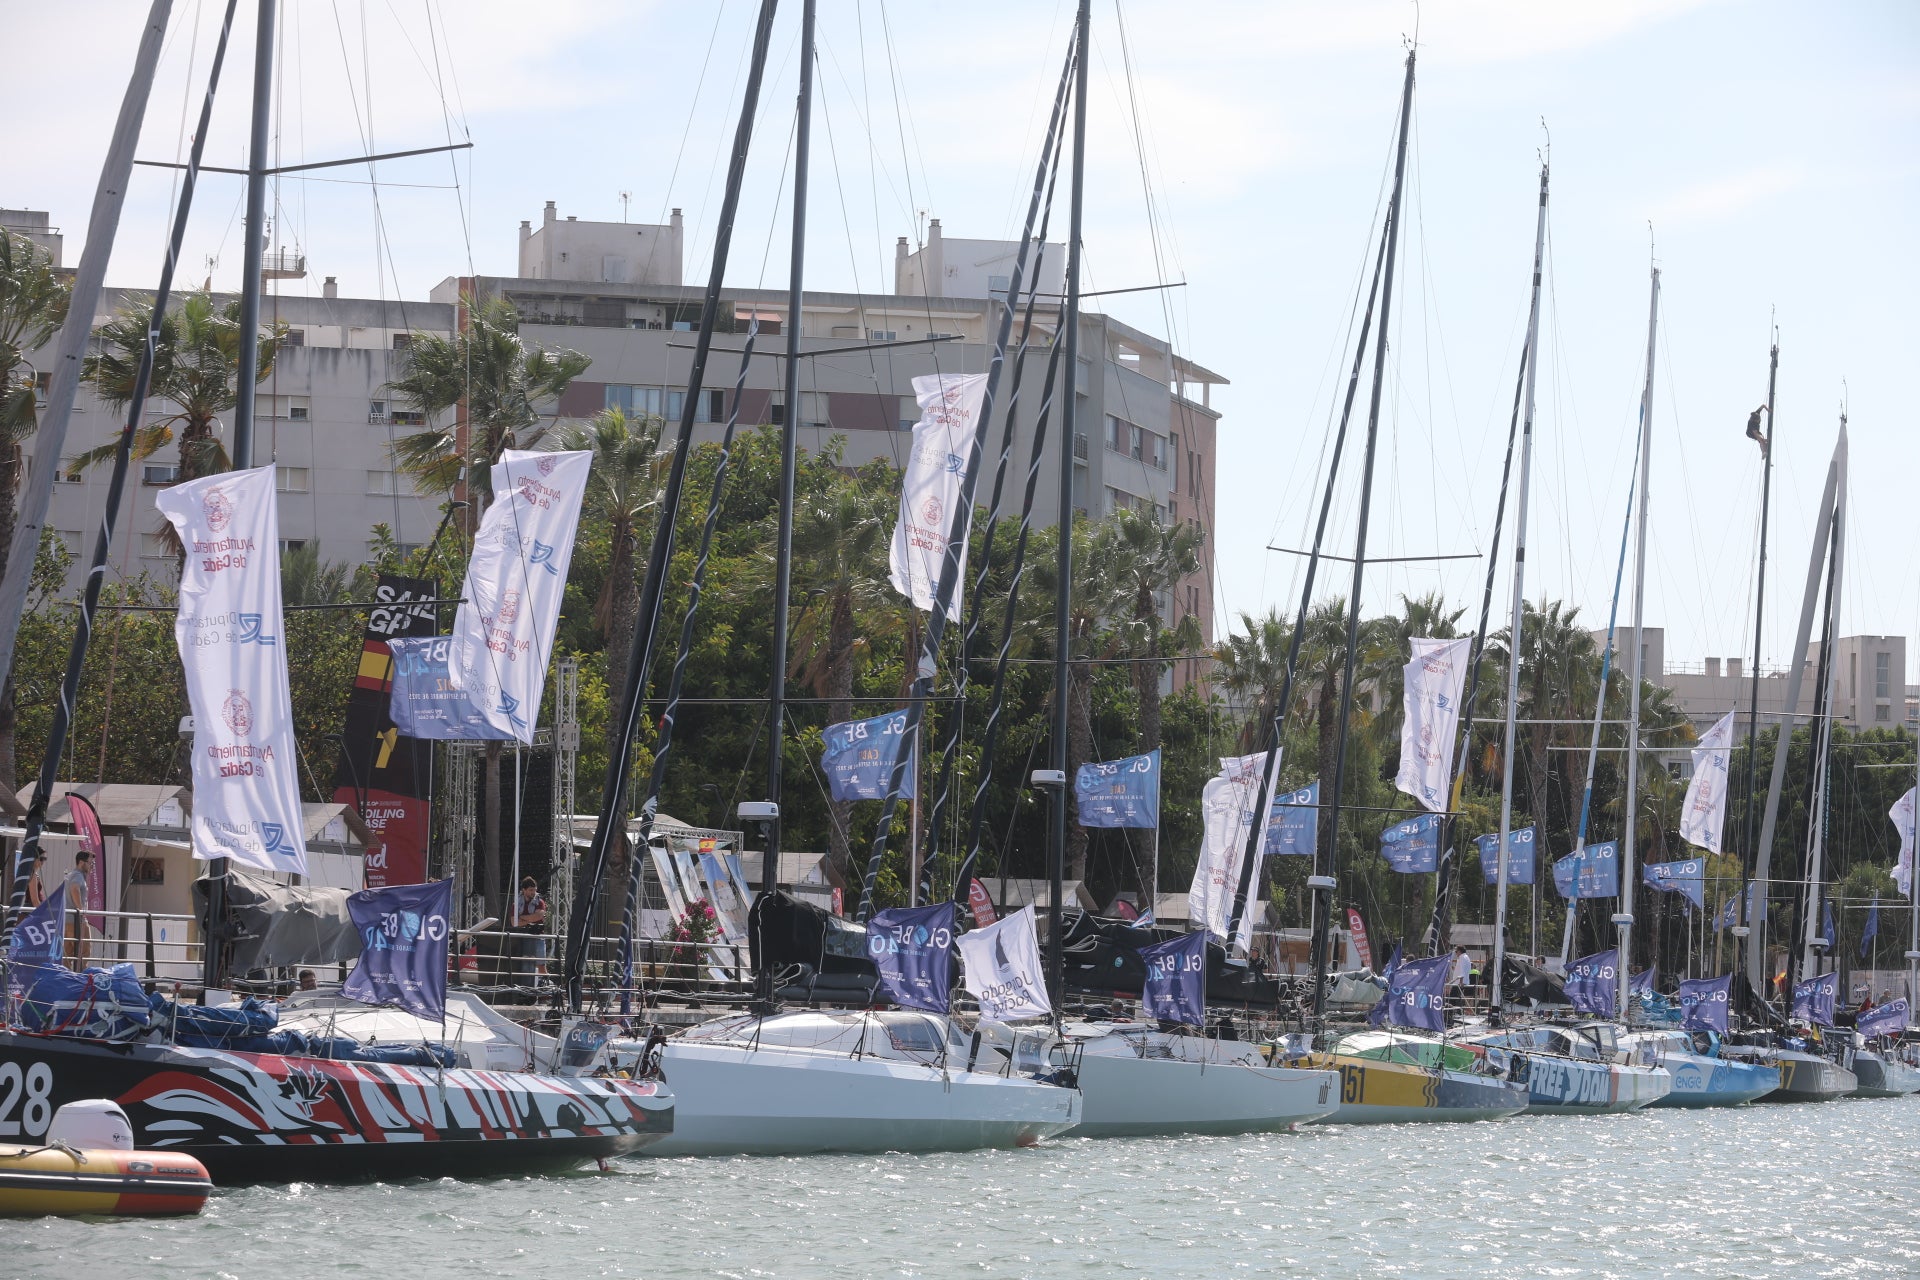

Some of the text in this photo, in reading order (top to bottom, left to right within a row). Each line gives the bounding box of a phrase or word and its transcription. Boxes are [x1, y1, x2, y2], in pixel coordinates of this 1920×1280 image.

[374, 585, 437, 620] SAIL
[368, 609, 412, 634] GP
[364, 808, 405, 818] OILING
[365, 819, 387, 828] ASE
[0, 1062, 53, 1136] 28
[1340, 1064, 1366, 1104] 151
